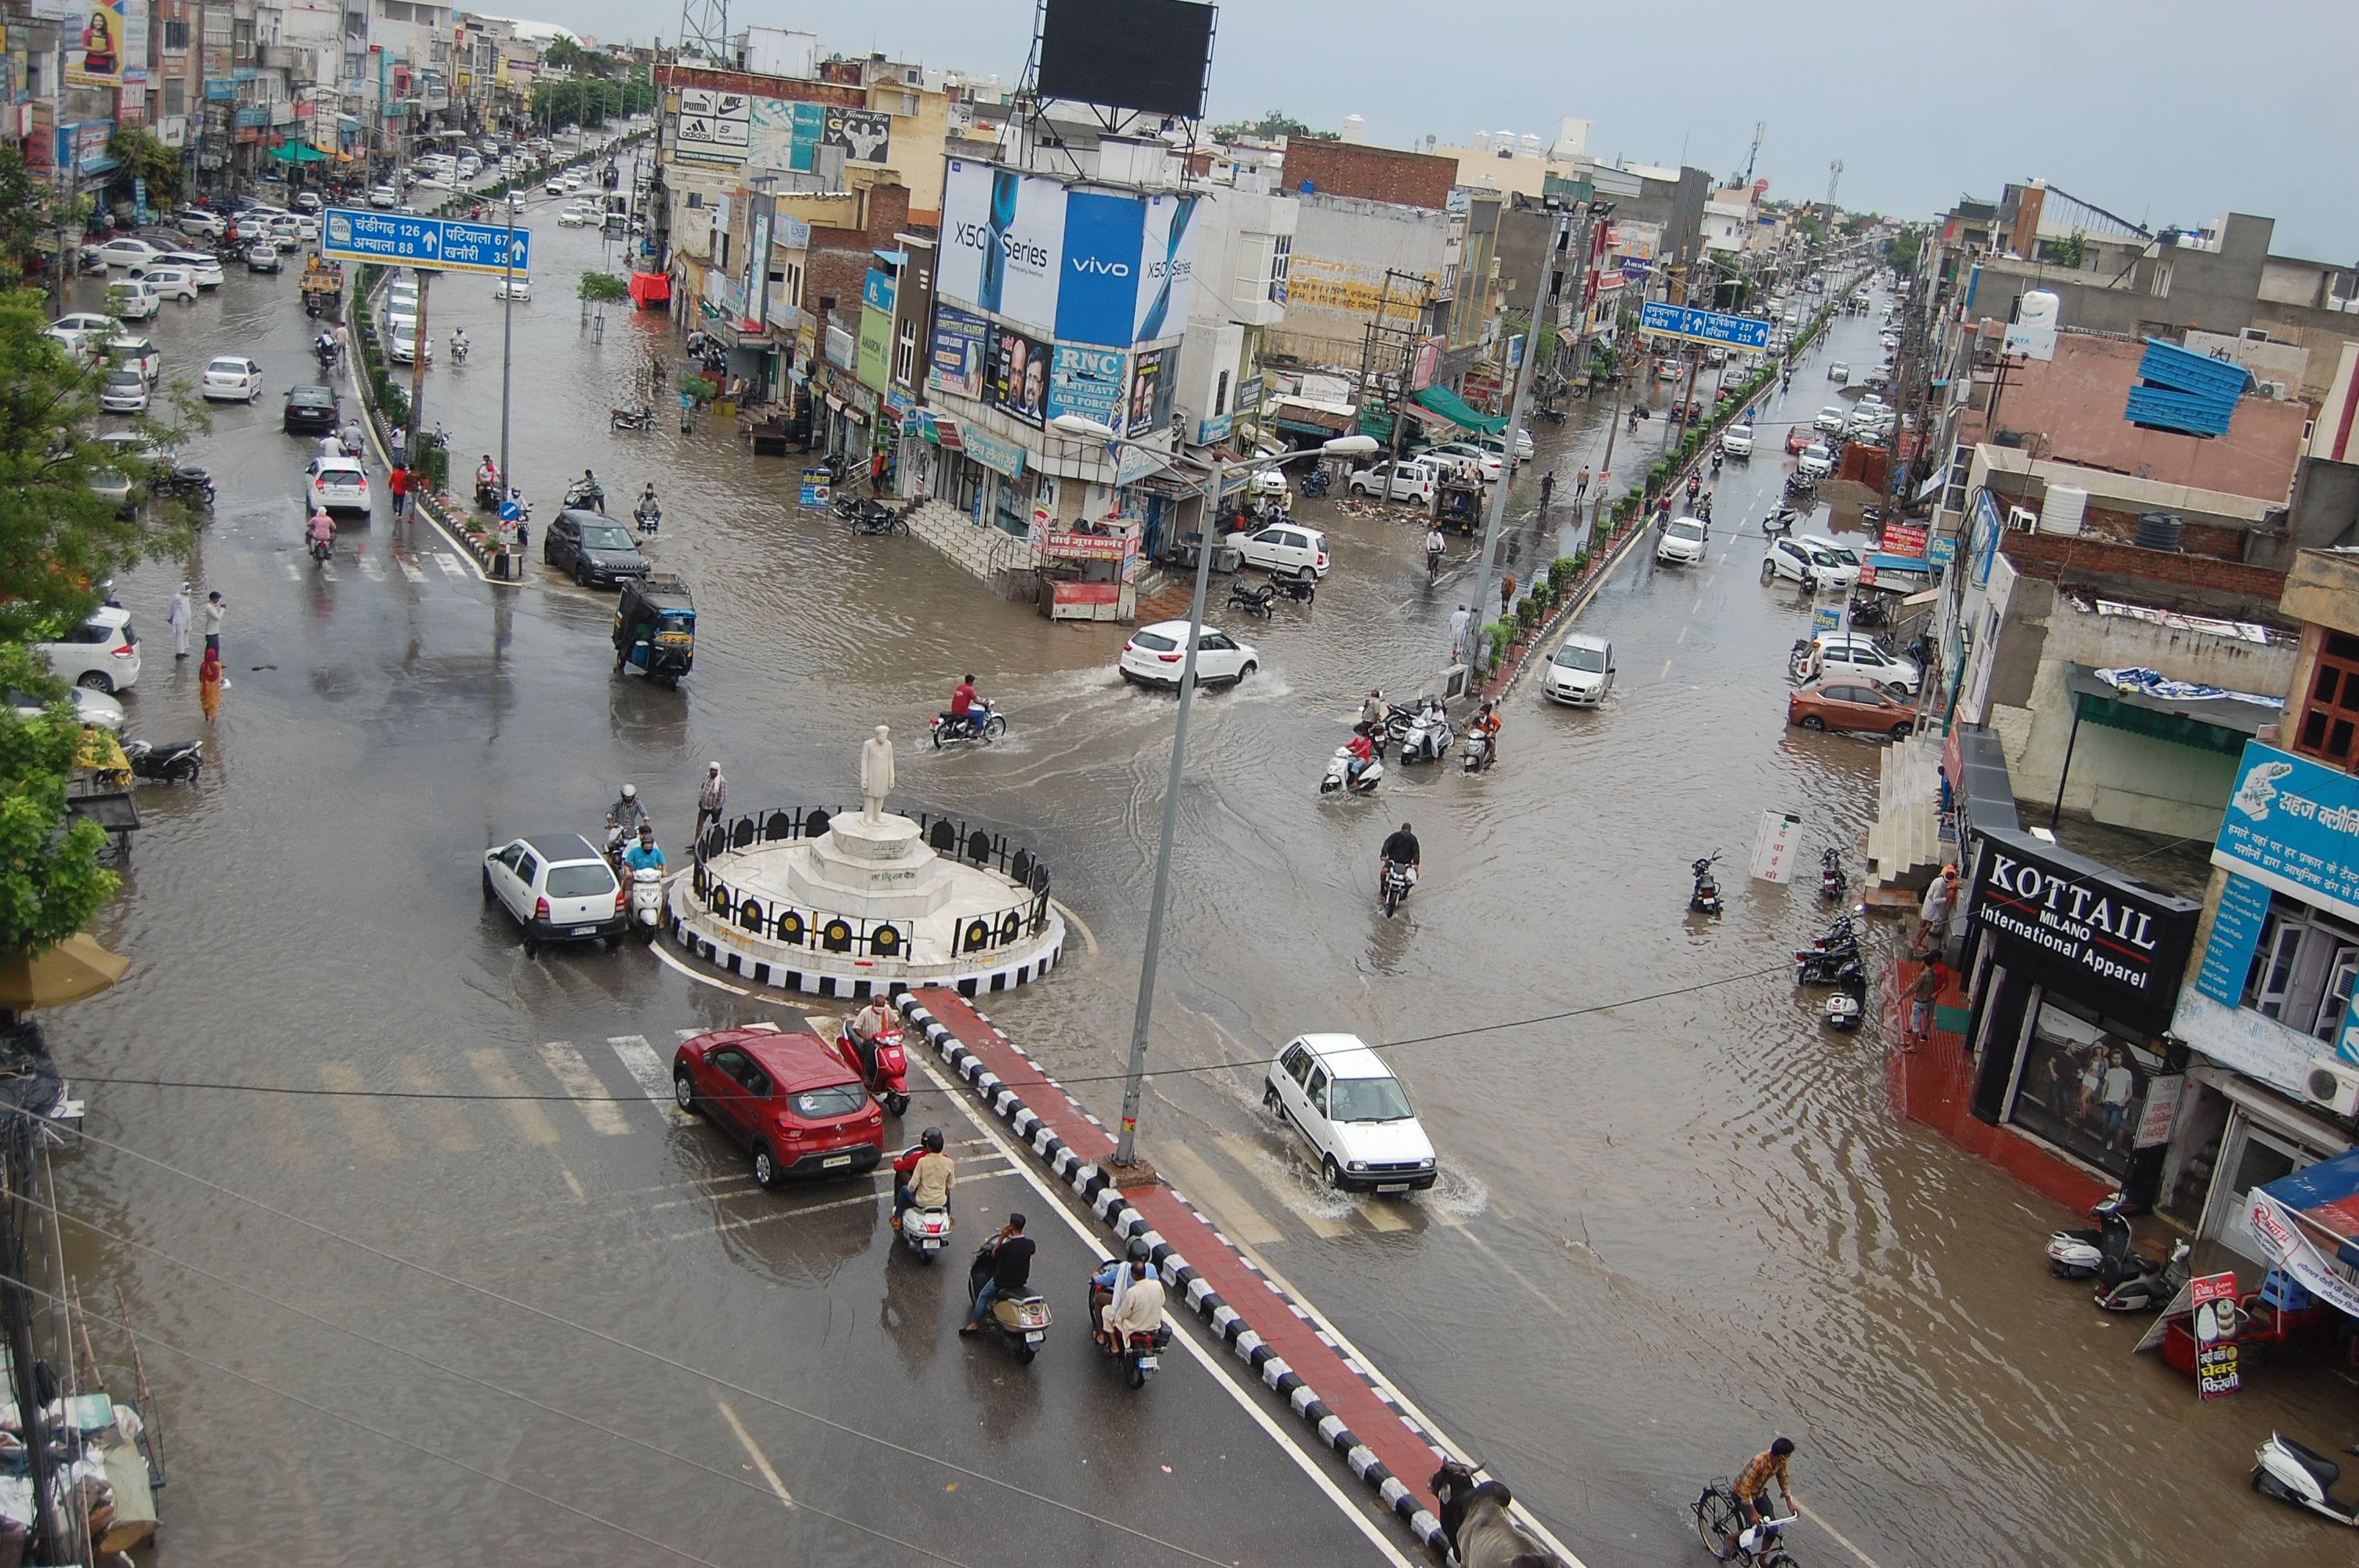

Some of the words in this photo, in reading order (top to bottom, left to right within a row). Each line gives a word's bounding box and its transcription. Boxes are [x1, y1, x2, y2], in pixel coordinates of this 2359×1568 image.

[683, 101, 707, 112] PUMA
[723, 96, 743, 107] NIKE
[842, 111, 871, 119] Fitness
[868, 114, 889, 122] First
[354, 216, 395, 237] चंडीगढ़
[400, 225, 420, 237] 126
[445, 226, 491, 245] पटियाला
[494, 235, 509, 246] 67
[955, 221, 986, 250] X50
[1002, 234, 1048, 268] Series
[354, 237, 395, 252] अम्बाला
[398, 242, 413, 254] 88
[493, 252, 508, 264] 35
[1072, 256, 1129, 277] vivo
[1147, 262, 1166, 278] X50
[1172, 260, 1192, 277] Series
[1647, 307, 1679, 318] यमुनानगर
[1708, 316, 1737, 328] ऋषिकेश
[1739, 323, 1754, 332] 257
[1705, 326, 1729, 339] हरिद्वार
[1737, 333, 1751, 343] 232
[2009, 336, 2030, 345] TATA
[1060, 349, 1117, 375] RNC
[1087, 384, 1116, 395] NAVY
[1055, 394, 1074, 404] AIR
[1078, 397, 1114, 409] FORCE
[2279, 791, 2317, 820] सहज
[2228, 824, 2249, 840] हमारे
[2252, 833, 2269, 848] यहां
[2270, 840, 2283, 854] पर
[2284, 846, 2297, 859] हर
[2299, 852, 2324, 869] प्रकार
[2326, 860, 2338, 874] के
[2234, 843, 2263, 861] मशीनों
[2263, 855, 2281, 869] द्वारा
[2284, 863, 2322, 885] आधुनिक
[2324, 878, 2339, 892] ढंग
[2342, 884, 2352, 897] से
[1988, 854, 2157, 950] KOTTAIL
[2039, 910, 2090, 941] MILANO
[1980, 902, 2078, 959] International
[2082, 949, 2147, 989] Apparel
[2201, 1360, 2237, 1376] घेवर
